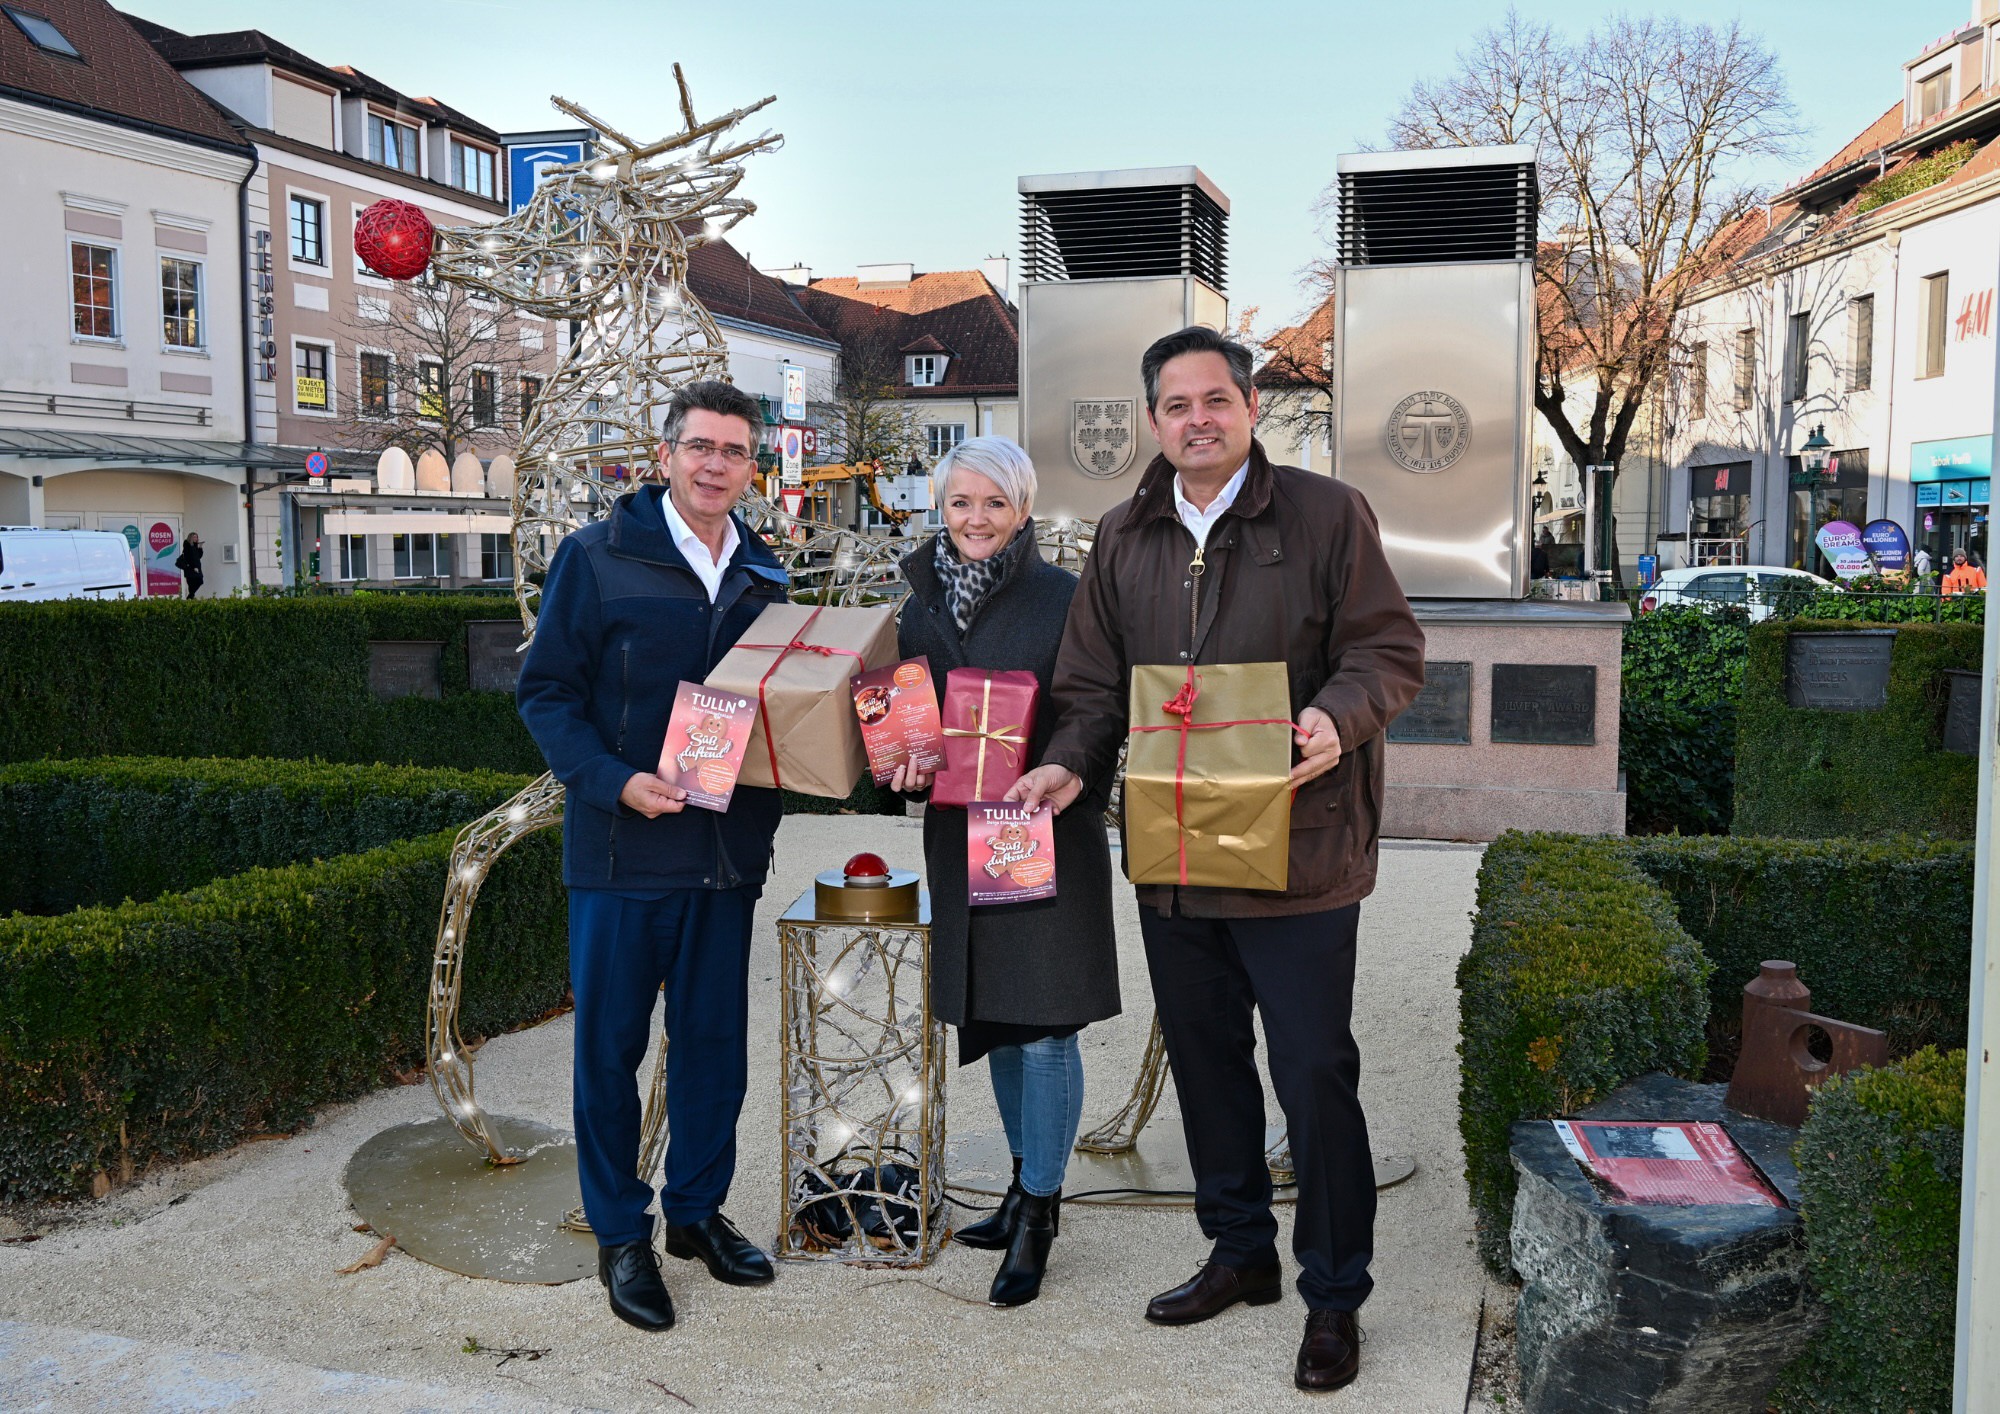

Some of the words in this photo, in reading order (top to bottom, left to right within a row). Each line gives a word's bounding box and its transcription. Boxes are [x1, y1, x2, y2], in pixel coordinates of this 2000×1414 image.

[256, 230, 277, 381] PENSION
[1955, 288, 1993, 342] H&M
[298, 378, 321, 387] OBJEKT
[1823, 534, 1847, 542] EURO
[1824, 539, 1860, 548] DREAMS
[692, 692, 736, 714] TULLN
[1548, 702, 1590, 713] AWARD
[690, 732, 718, 746] Süß
[682, 746, 724, 760] duftend
[984, 808, 1031, 820] TULLN
[993, 842, 1021, 854] Süß
[988, 848, 1033, 866] duftend
